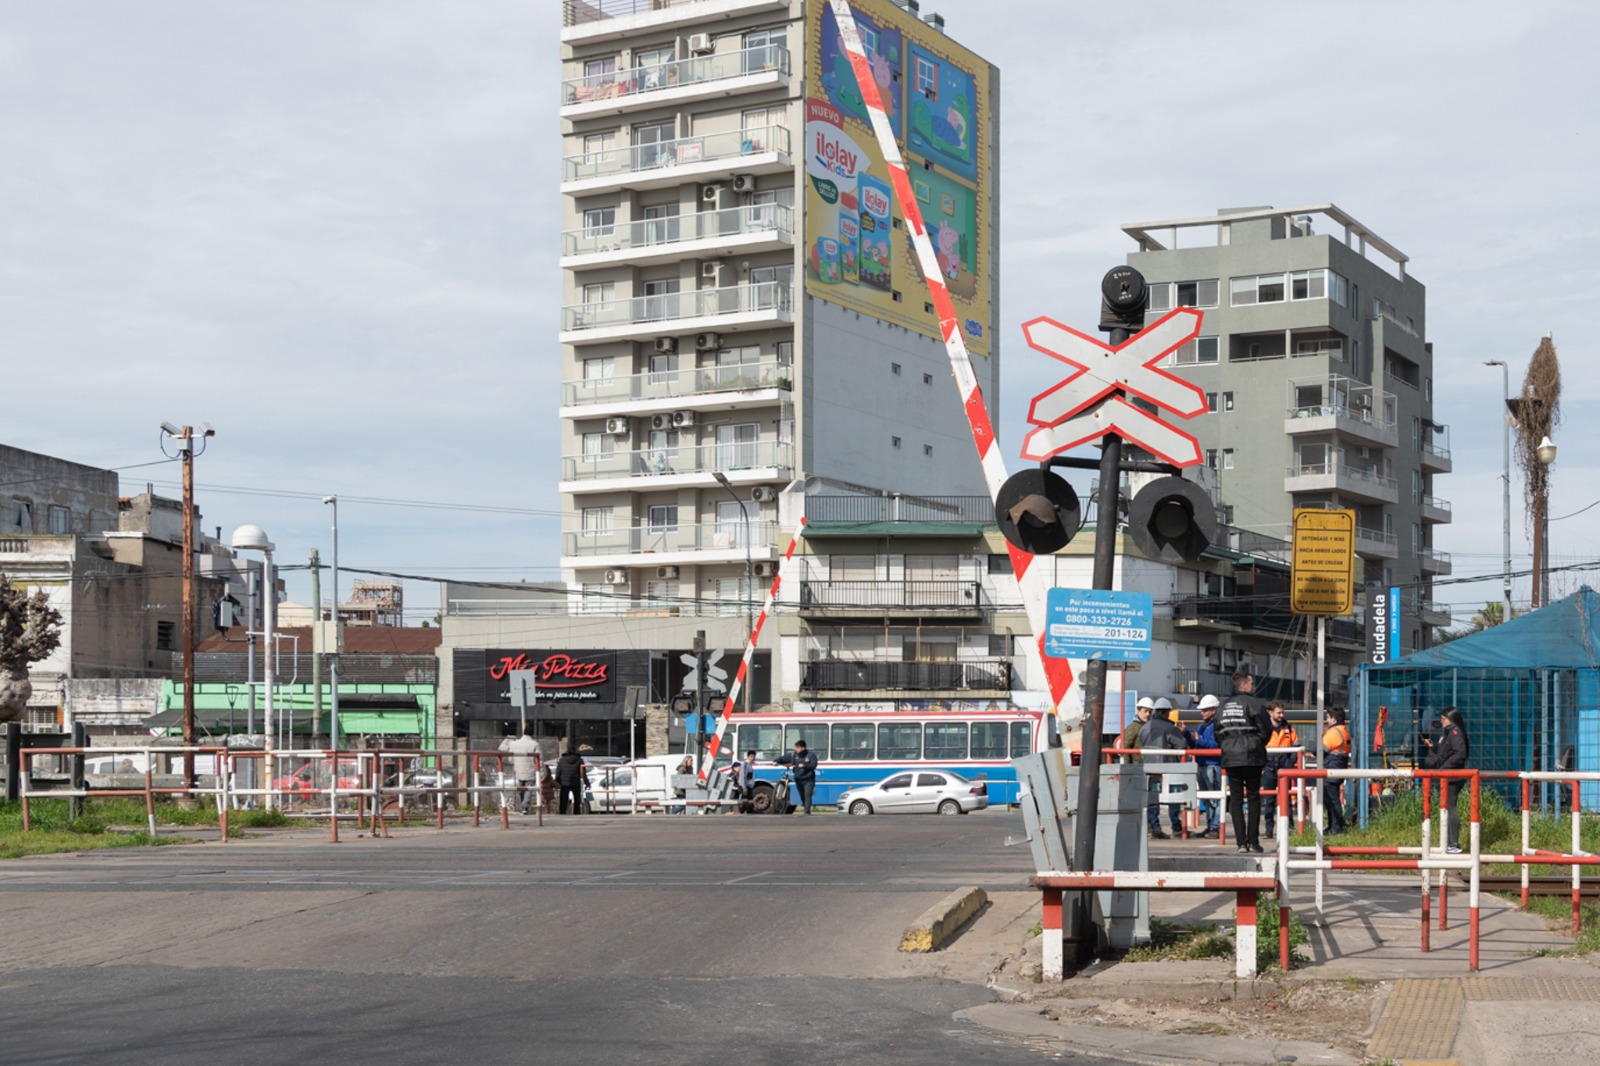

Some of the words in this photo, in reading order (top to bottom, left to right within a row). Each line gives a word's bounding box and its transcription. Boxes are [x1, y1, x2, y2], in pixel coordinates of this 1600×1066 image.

[811, 106, 840, 123] NUEVO
[816, 131, 857, 174] ilolay
[826, 160, 846, 178] Kids
[1082, 600, 1130, 608] inconvenientes
[1066, 614, 1132, 626] 0800-333-2726
[1104, 629, 1144, 639] 201-124
[1372, 594, 1385, 664] Ciudadela
[542, 654, 608, 679] Pizza
